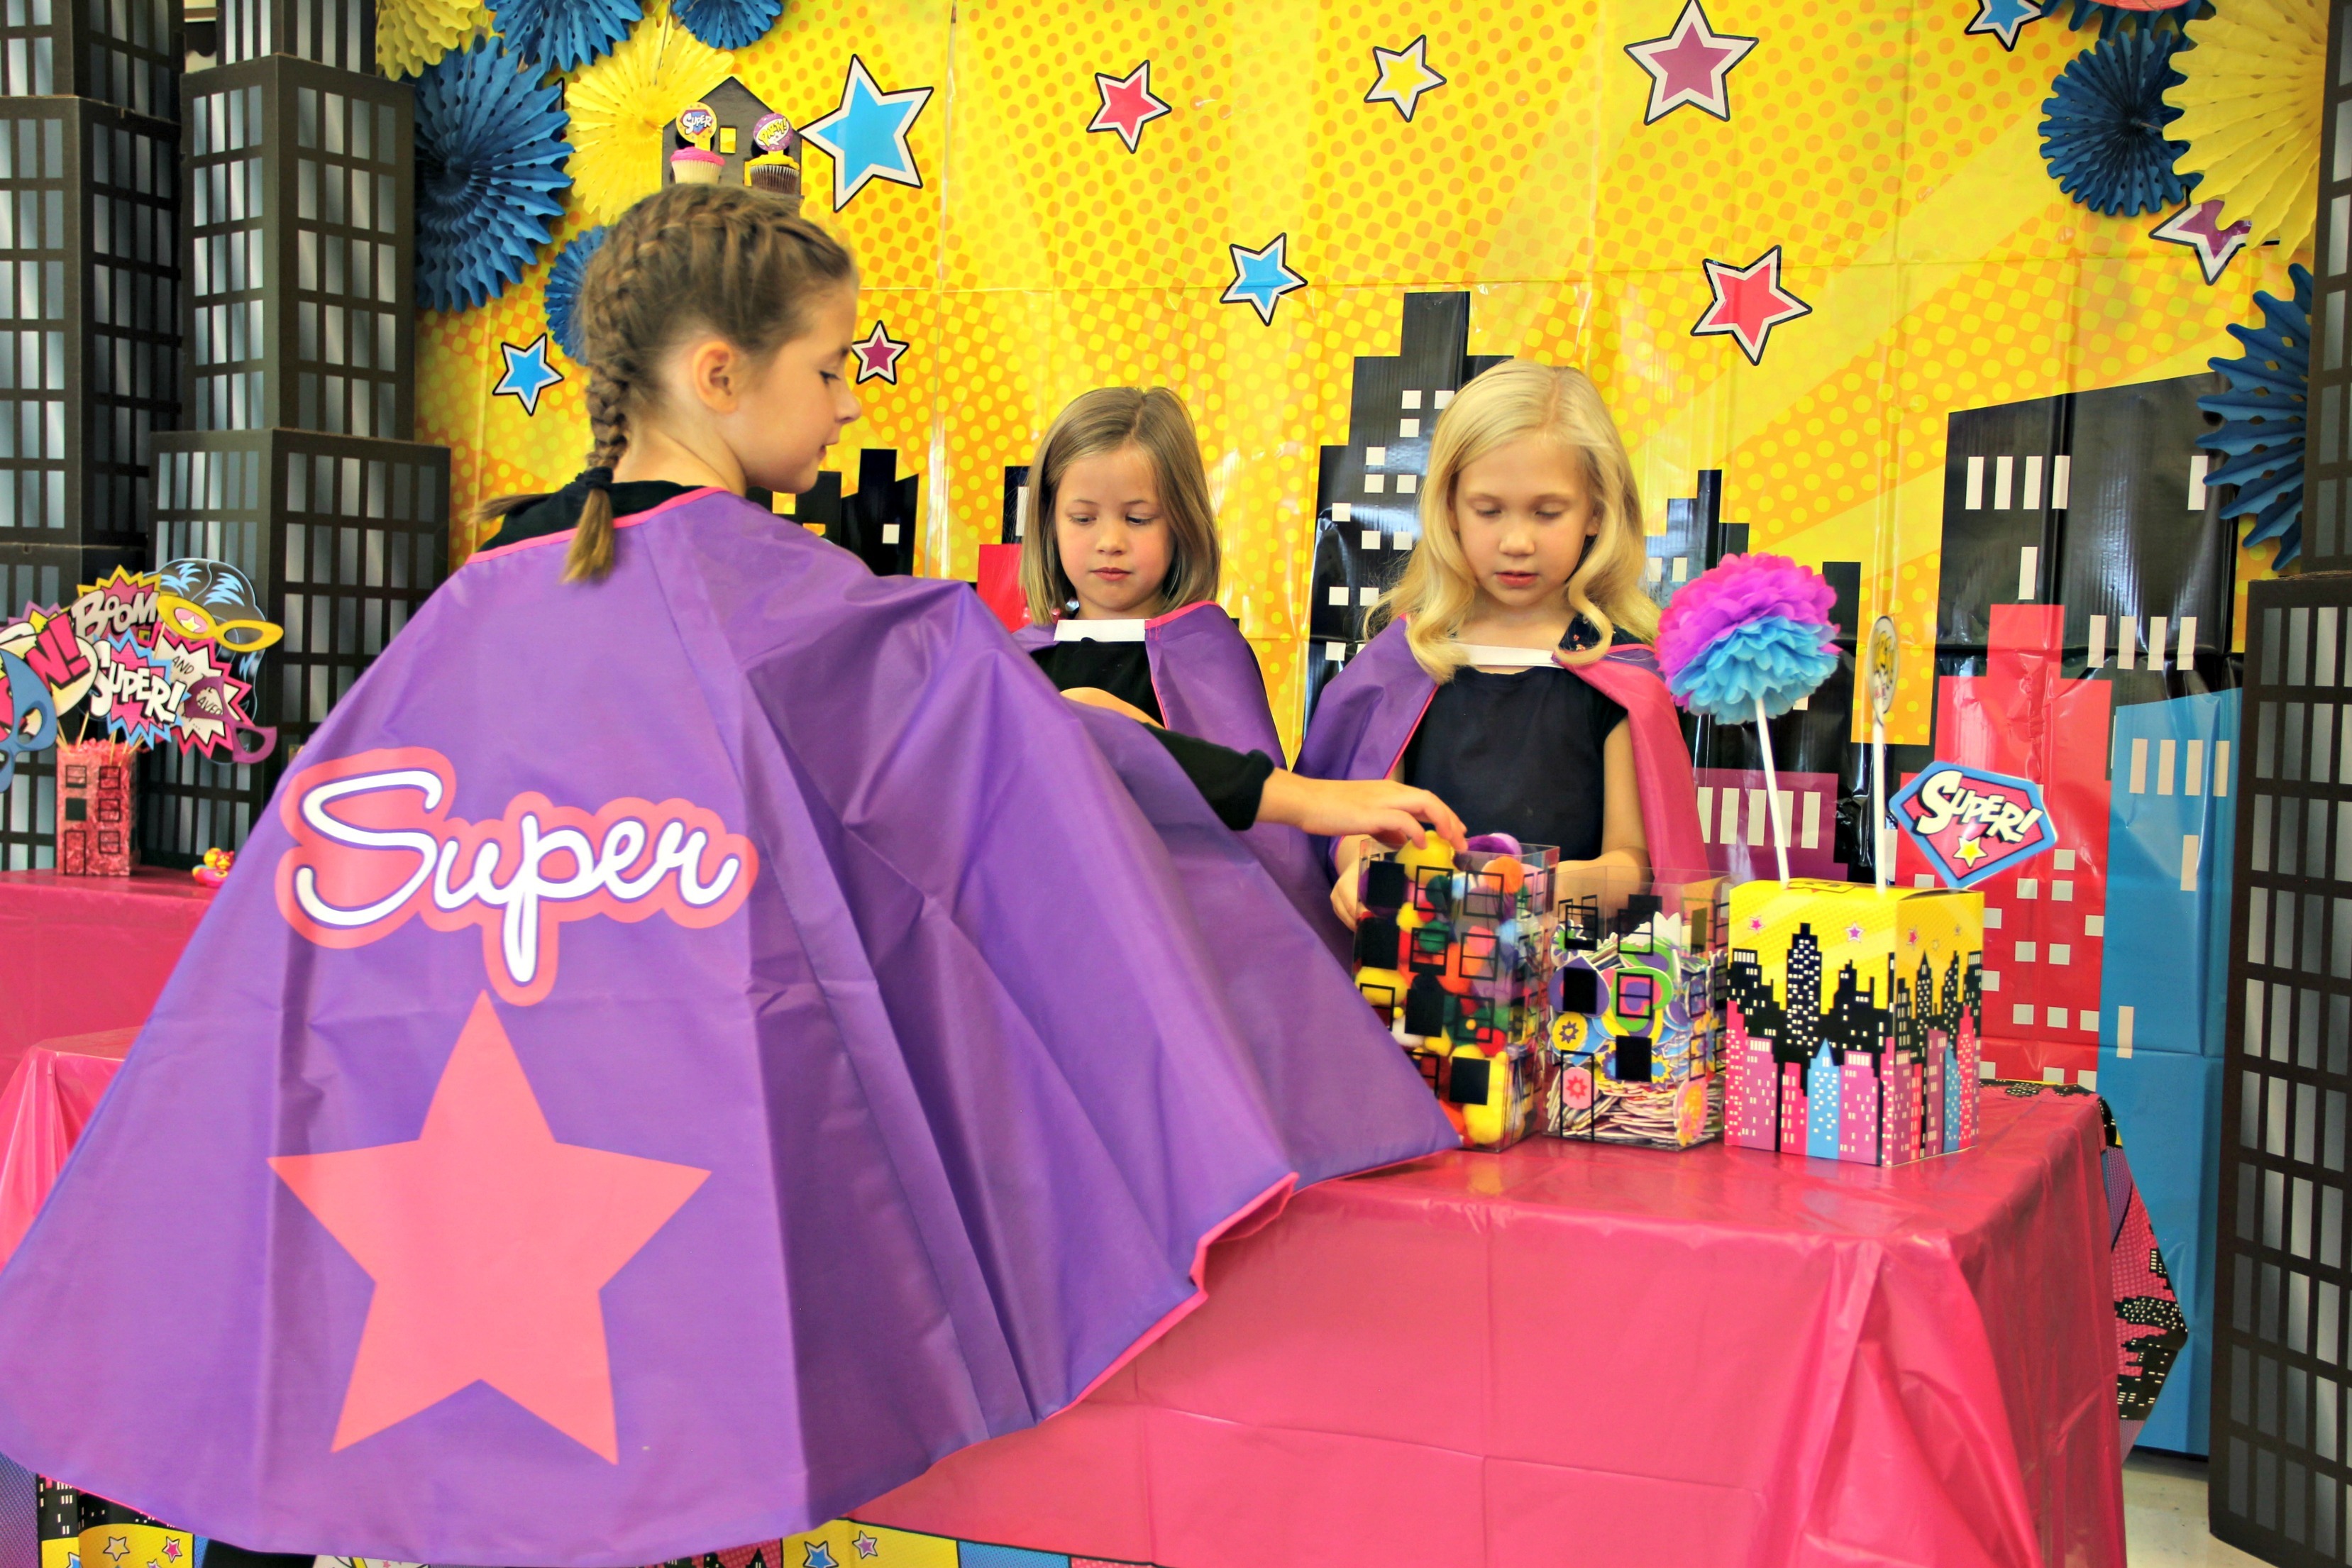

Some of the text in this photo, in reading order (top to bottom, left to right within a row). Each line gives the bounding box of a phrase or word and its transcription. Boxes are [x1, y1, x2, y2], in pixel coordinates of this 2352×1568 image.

[682, 112, 712, 136] SUPER
[758, 117, 788, 148] PARTY!
[90, 639, 187, 724] SUPER!
[172, 655, 194, 675] AND
[1916, 769, 2044, 844] SUPER!
[294, 766, 743, 983] Super
